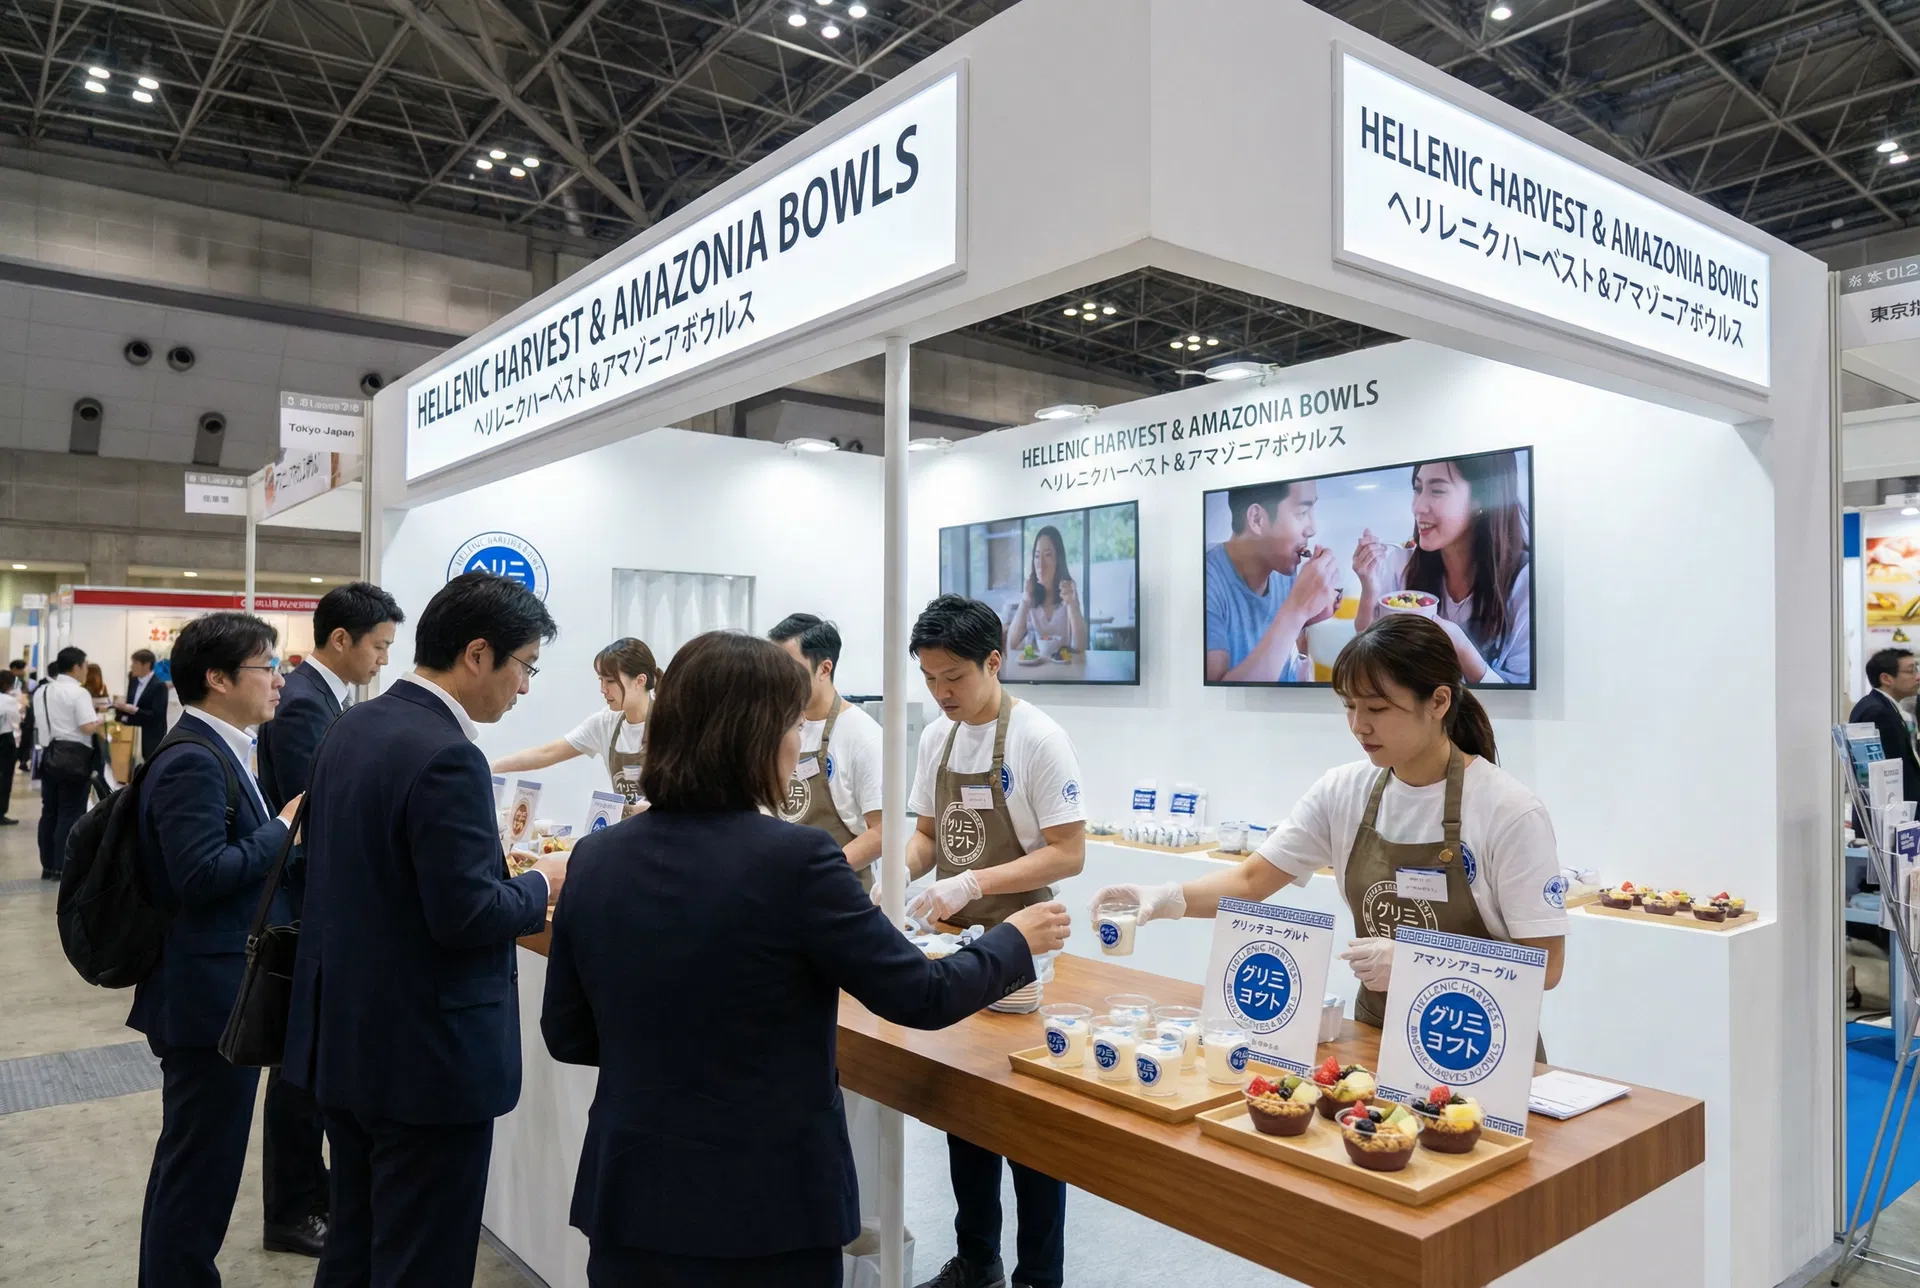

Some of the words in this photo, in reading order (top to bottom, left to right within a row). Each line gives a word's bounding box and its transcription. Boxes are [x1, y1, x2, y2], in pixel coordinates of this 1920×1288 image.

[1361, 106, 1483, 197] HELLENIC
[1490, 162, 1588, 239] HARVEST
[1592, 209, 1607, 247] &
[1611, 217, 1704, 287] AMAZONIA
[1708, 259, 1759, 309] BOWLS
[418, 358, 490, 429] HELLENIC
[495, 307, 584, 393] HARVEST
[589, 298, 606, 346] &
[612, 209, 768, 336] AMAZONIA
[778, 124, 919, 254] BOWLS
[289, 423, 321, 435] Tokyo
[1022, 437, 1090, 469] HELLENIC
[1094, 421, 1167, 456] HARVEST
[1171, 418, 1184, 441] &
[1188, 397, 1293, 438] AMAZONIA
[1300, 379, 1379, 418] BOWLS
[1242, 964, 1285, 990] グリミ
[1429, 1005, 1485, 1035] グリミ
[1426, 1030, 1480, 1059] ヨフト
